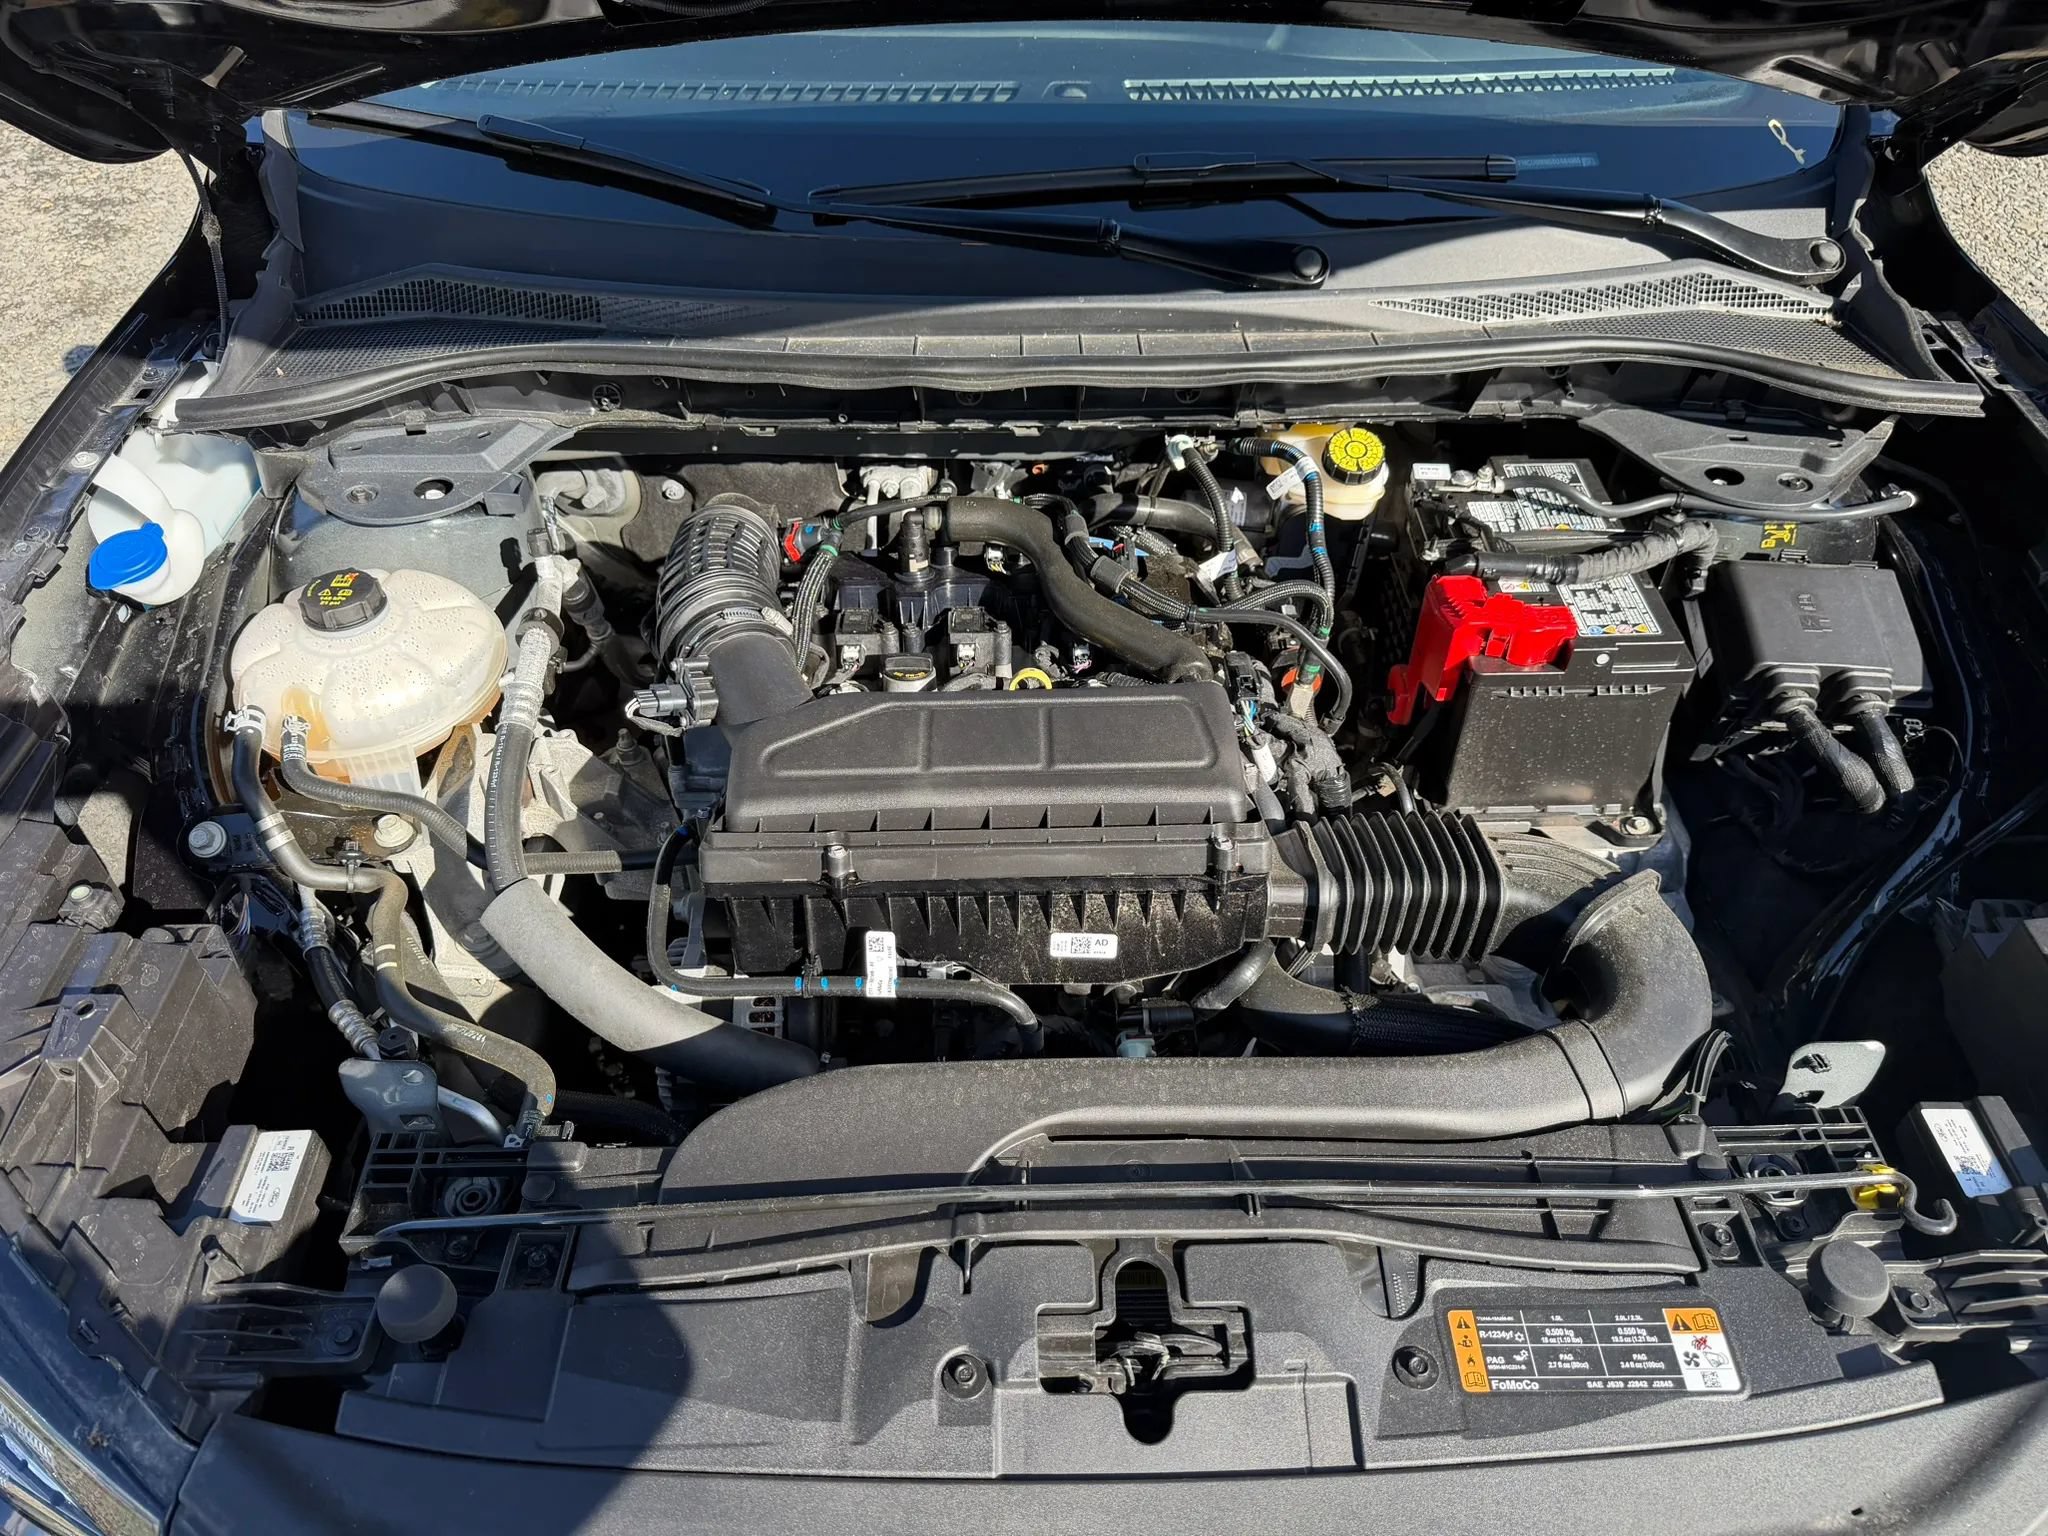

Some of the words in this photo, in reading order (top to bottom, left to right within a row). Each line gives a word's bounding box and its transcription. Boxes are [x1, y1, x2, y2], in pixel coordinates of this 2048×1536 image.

[1479, 1330, 1514, 1340] R-1234yf
[1545, 1328, 1564, 1336] 0.500
[1564, 1328, 1574, 1337] kg
[1617, 1327, 1636, 1335] 0.550
[1637, 1327, 1647, 1336] kg
[1491, 1379, 1539, 1390] FoMoCo
